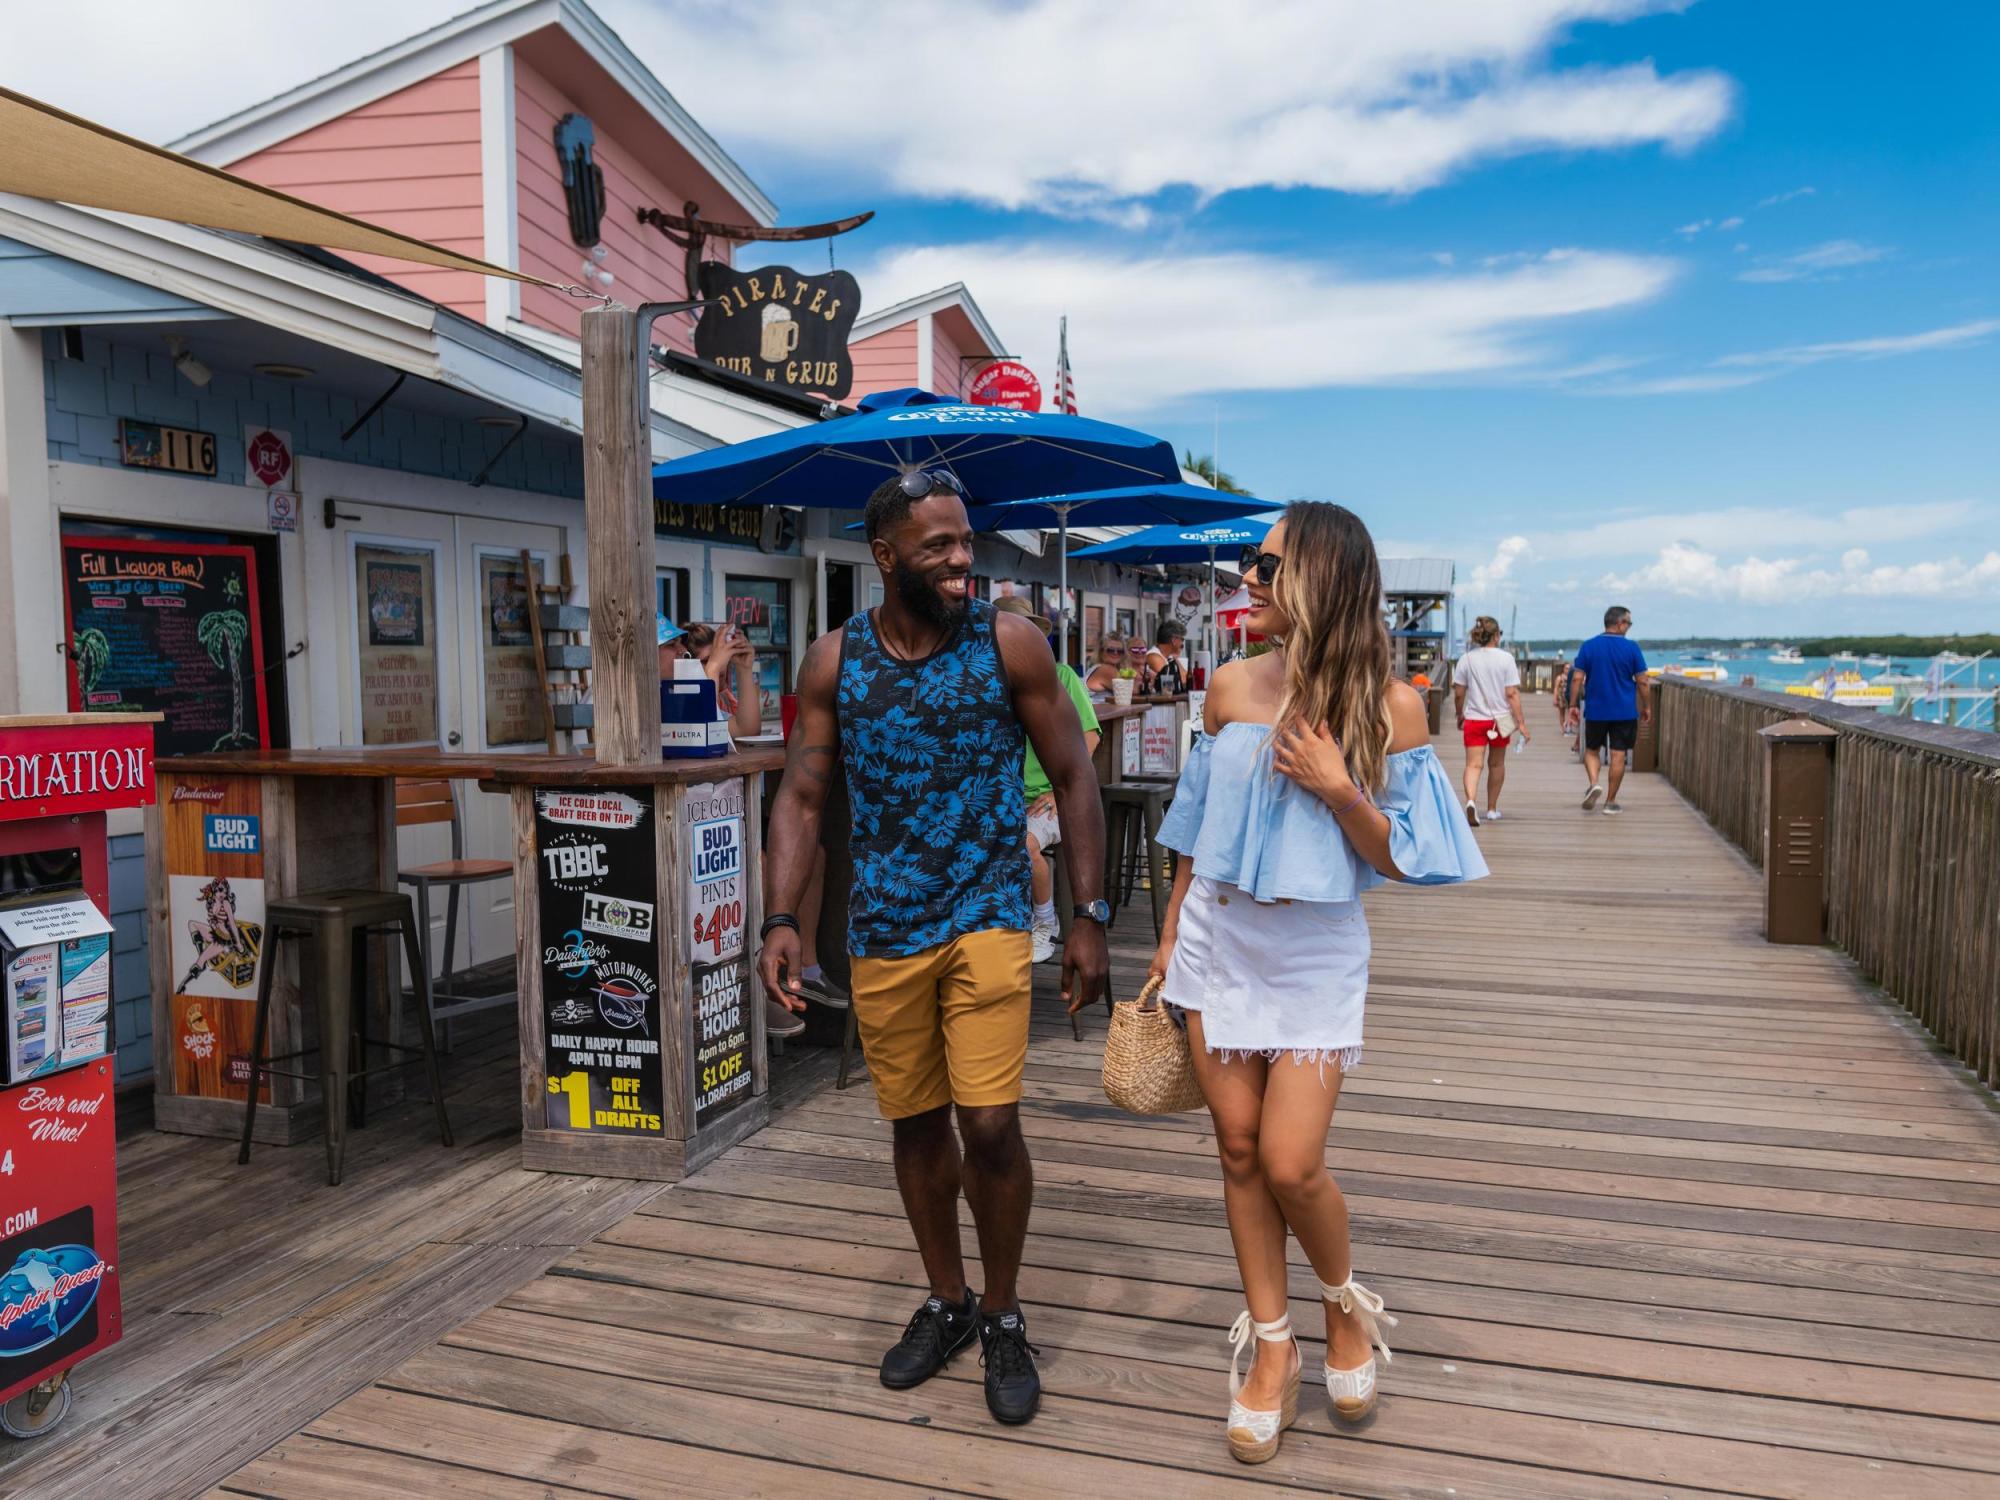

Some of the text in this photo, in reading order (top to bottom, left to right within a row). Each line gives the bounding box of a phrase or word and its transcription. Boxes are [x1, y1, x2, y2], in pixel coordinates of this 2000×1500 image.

[718, 274, 841, 321] PIRATES
[765, 368, 776, 383] N
[786, 360, 838, 387] GRUB
[972, 365, 1041, 395] Sugar Daddy's
[1001, 390, 1030, 400] Flavors
[887, 410, 1036, 422] Corona
[937, 416, 1016, 424] Extra
[167, 431, 213, 471] 116
[260, 450, 280, 466] RF
[1179, 531, 1252, 540] Corona
[726, 597, 761, 625] OPEN
[174, 786, 224, 800] Budweiser
[559, 796, 623, 811] ICE COLD LOCAL
[577, 811, 597, 821] BEER
[600, 812, 611, 822] ON
[615, 813, 633, 824] TAP!
[687, 795, 743, 822] ICE COLD
[214, 818, 249, 834] BUD
[208, 833, 256, 850] LIGHT
[550, 833, 598, 847] TAMPA BAY
[702, 824, 732, 851] BUD
[543, 843, 609, 880] TBBC
[697, 846, 738, 877] LIGHT
[554, 881, 589, 891] BREWING
[701, 877, 736, 904] PINTS
[14, 919, 34, 927] please
[60, 912, 71, 921] gift
[583, 920, 650, 937] BREWING COMPANY
[18, 952, 52, 965] SUNSHINE
[544, 940, 610, 964] Daughters
[594, 961, 657, 994] MOTORWORKS
[702, 963, 738, 996] DAILY
[699, 983, 742, 1020] HAPPY
[703, 1006, 740, 1041] HOUR
[184, 1031, 216, 1050] SHOCK
[551, 1034, 659, 1054] DAILY HAPPY HOUR
[698, 1031, 745, 1064] 4pm to 6pm
[193, 1045, 213, 1059] TOP
[568, 1051, 642, 1069] 4PM TO 6PM
[232, 1060, 251, 1072] STEL
[232, 1070, 264, 1081] ARTS
[703, 1052, 743, 1091] $1 OFF
[611, 1077, 641, 1093] OFF
[708, 1081, 733, 1107] DRAFT
[734, 1070, 752, 1092] BEER
[18, 1087, 104, 1115] Beer and
[547, 1071, 592, 1129] $1
[612, 1094, 642, 1111] ALL
[28, 1117, 88, 1142] Wine!
[595, 1110, 661, 1130] DRAFTS
[1, 1150, 15, 1176] 4
[0, 1207, 38, 1239] .COM
[53, 1261, 105, 1298] Quest
